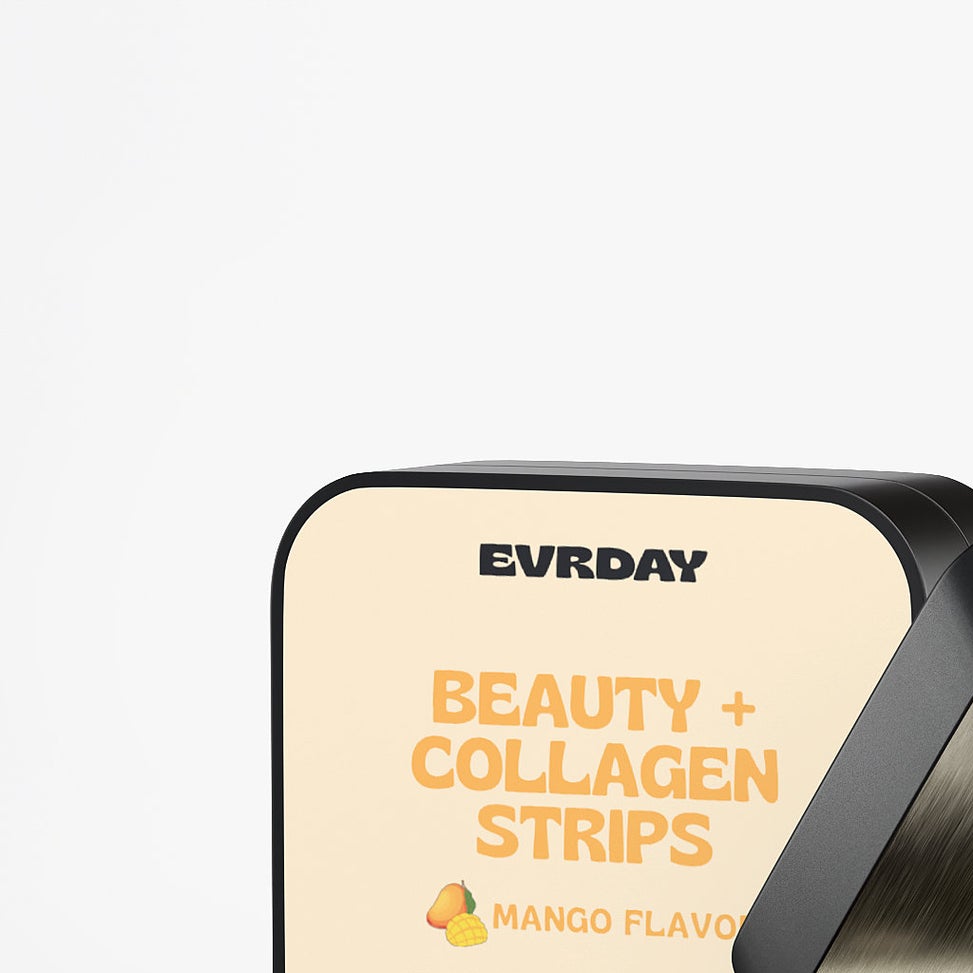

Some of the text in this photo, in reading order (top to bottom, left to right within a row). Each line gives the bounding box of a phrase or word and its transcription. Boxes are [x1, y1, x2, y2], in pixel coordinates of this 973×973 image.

[479, 543, 707, 582] EVRDAY
[432, 670, 756, 733] BEAUTY +
[411, 735, 779, 803] COLLAGEN
[476, 804, 713, 867] STRIPS
[493, 903, 612, 934] MANGO
